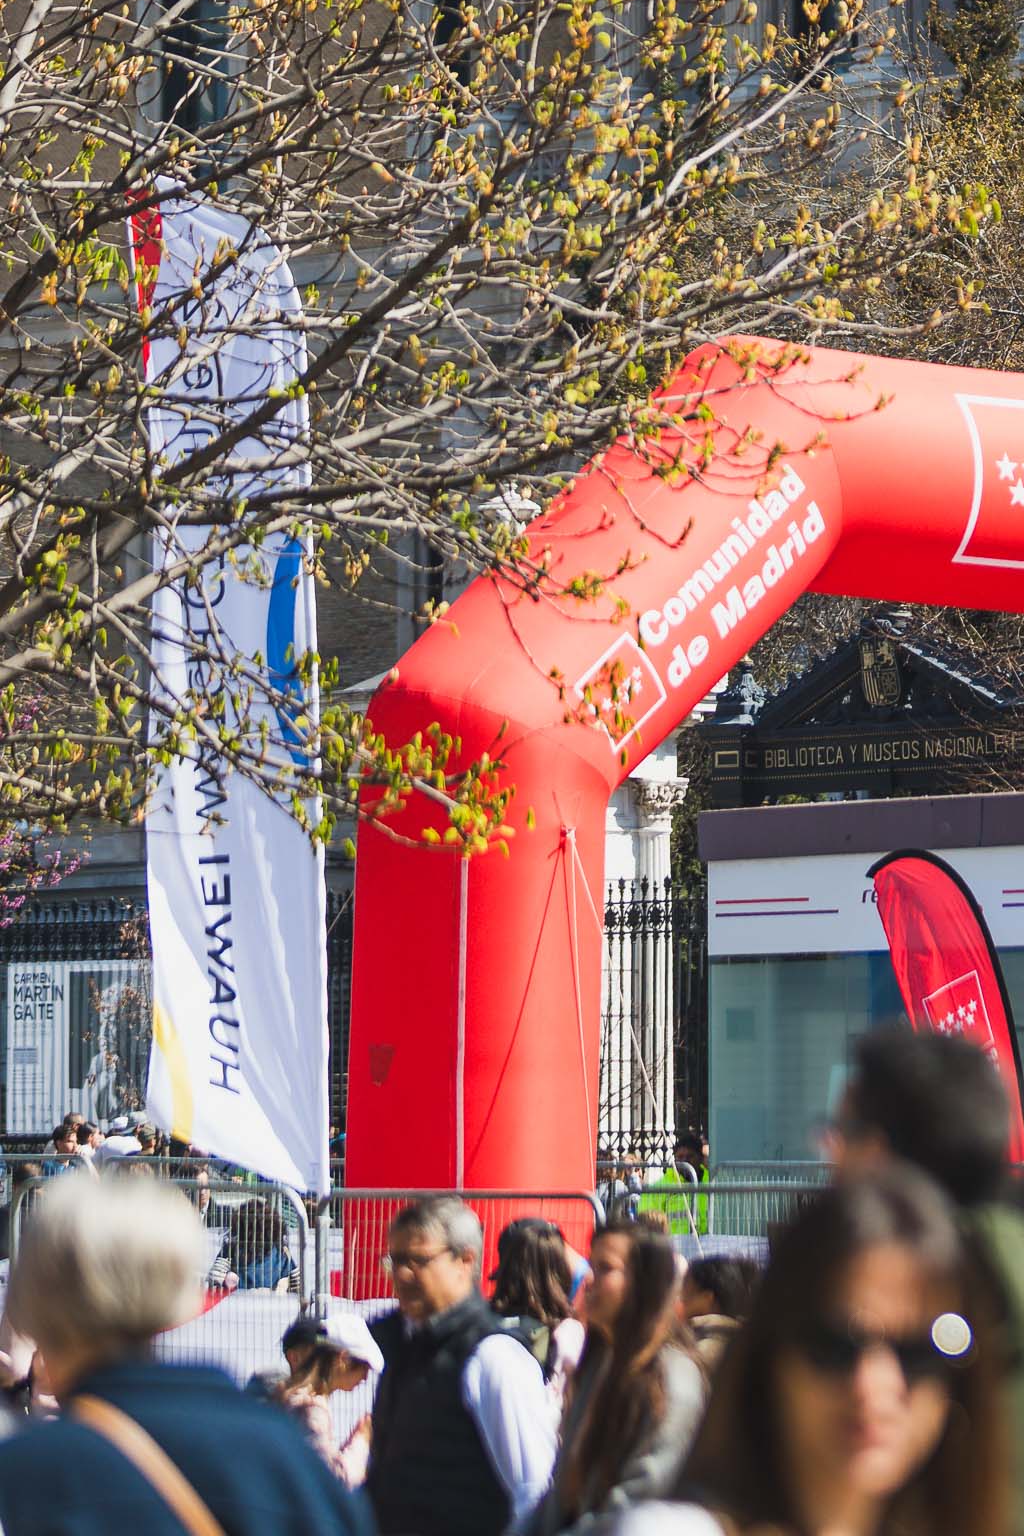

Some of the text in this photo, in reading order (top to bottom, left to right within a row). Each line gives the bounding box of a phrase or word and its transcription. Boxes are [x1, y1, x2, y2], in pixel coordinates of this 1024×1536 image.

[638, 464, 806, 647] Comunidad
[667, 500, 826, 688] de Madrid
[764, 744, 844, 770] BIBLIOTECA
[849, 743, 858, 762] Y
[862, 741, 920, 763] MUSEOS
[13, 1003, 54, 1021] GAITE
